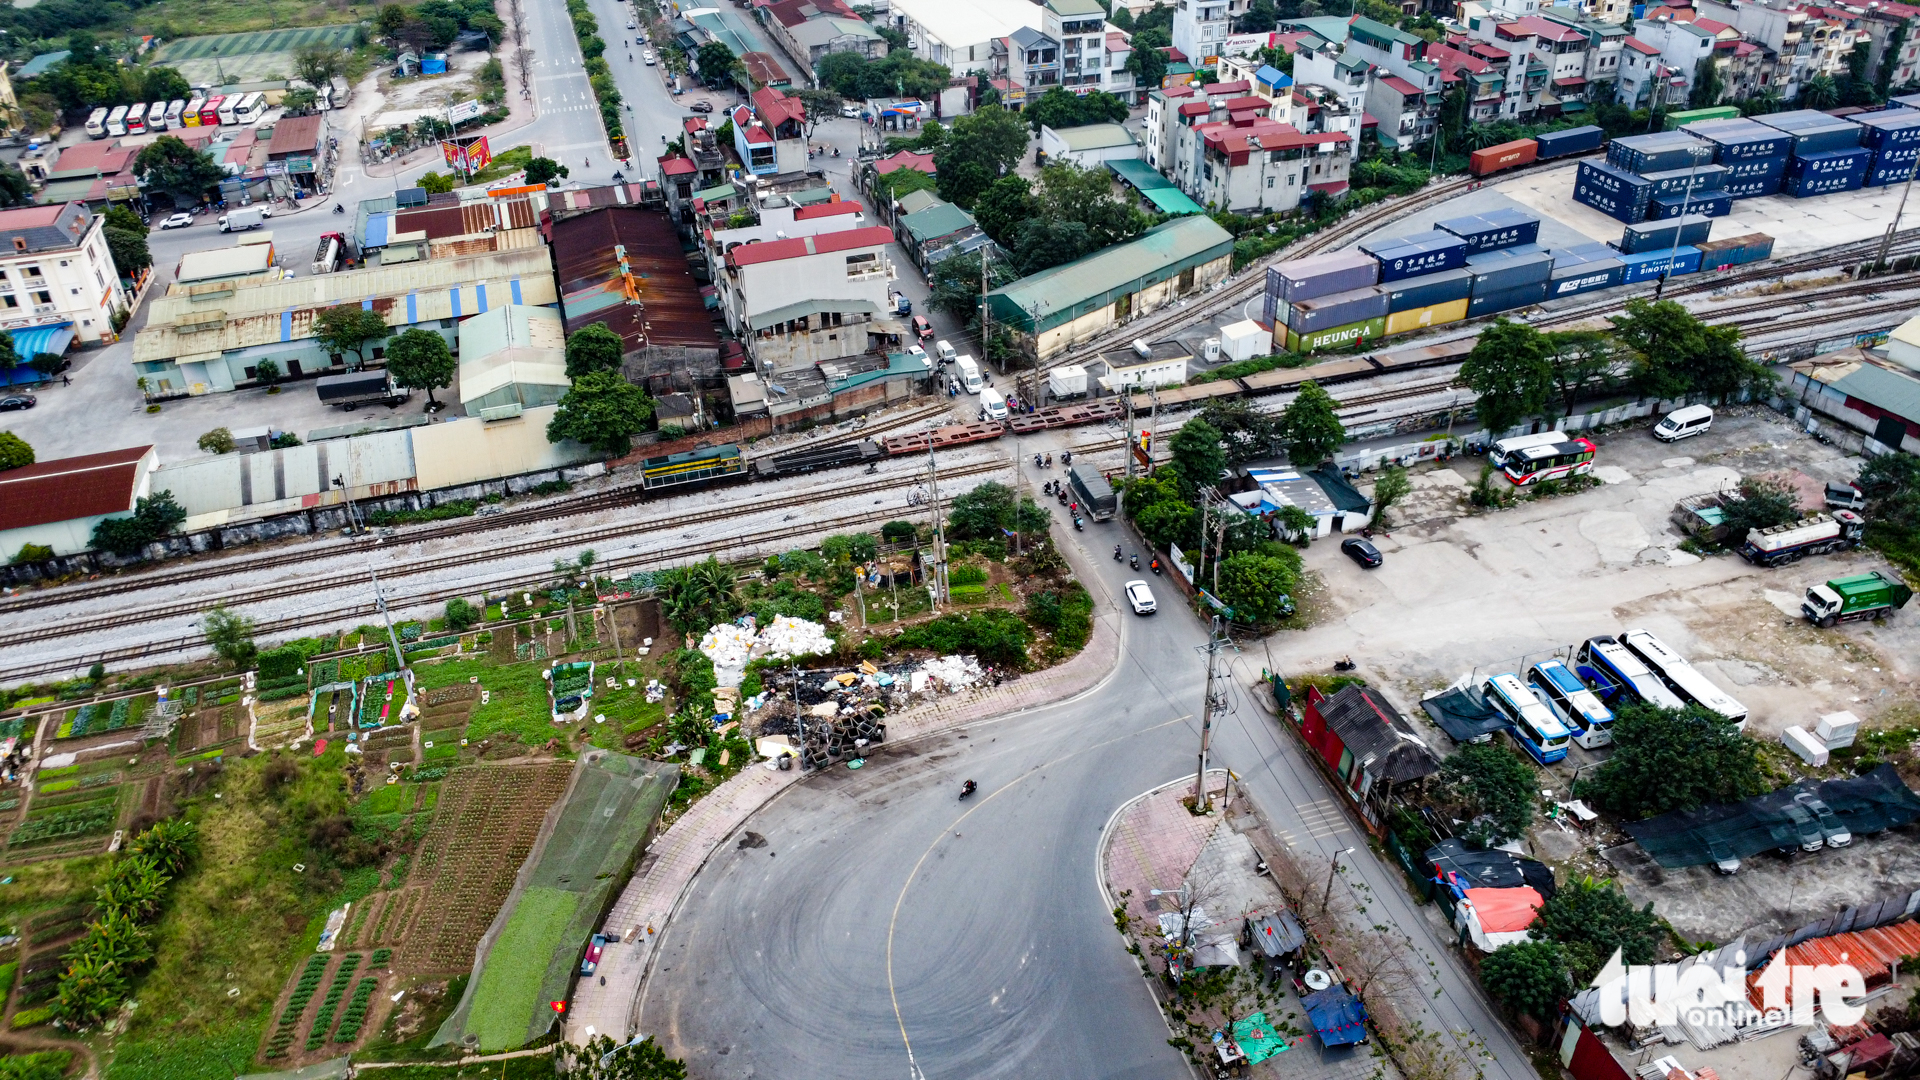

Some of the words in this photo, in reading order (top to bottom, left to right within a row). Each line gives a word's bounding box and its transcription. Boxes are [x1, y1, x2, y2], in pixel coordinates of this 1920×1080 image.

[1481, 230, 1518, 244] 中国铁路
[1407, 253, 1446, 267] 中国铁路
[1640, 261, 1685, 275] SINOTRANS
[1313, 326, 1371, 348] HEUNG-A
